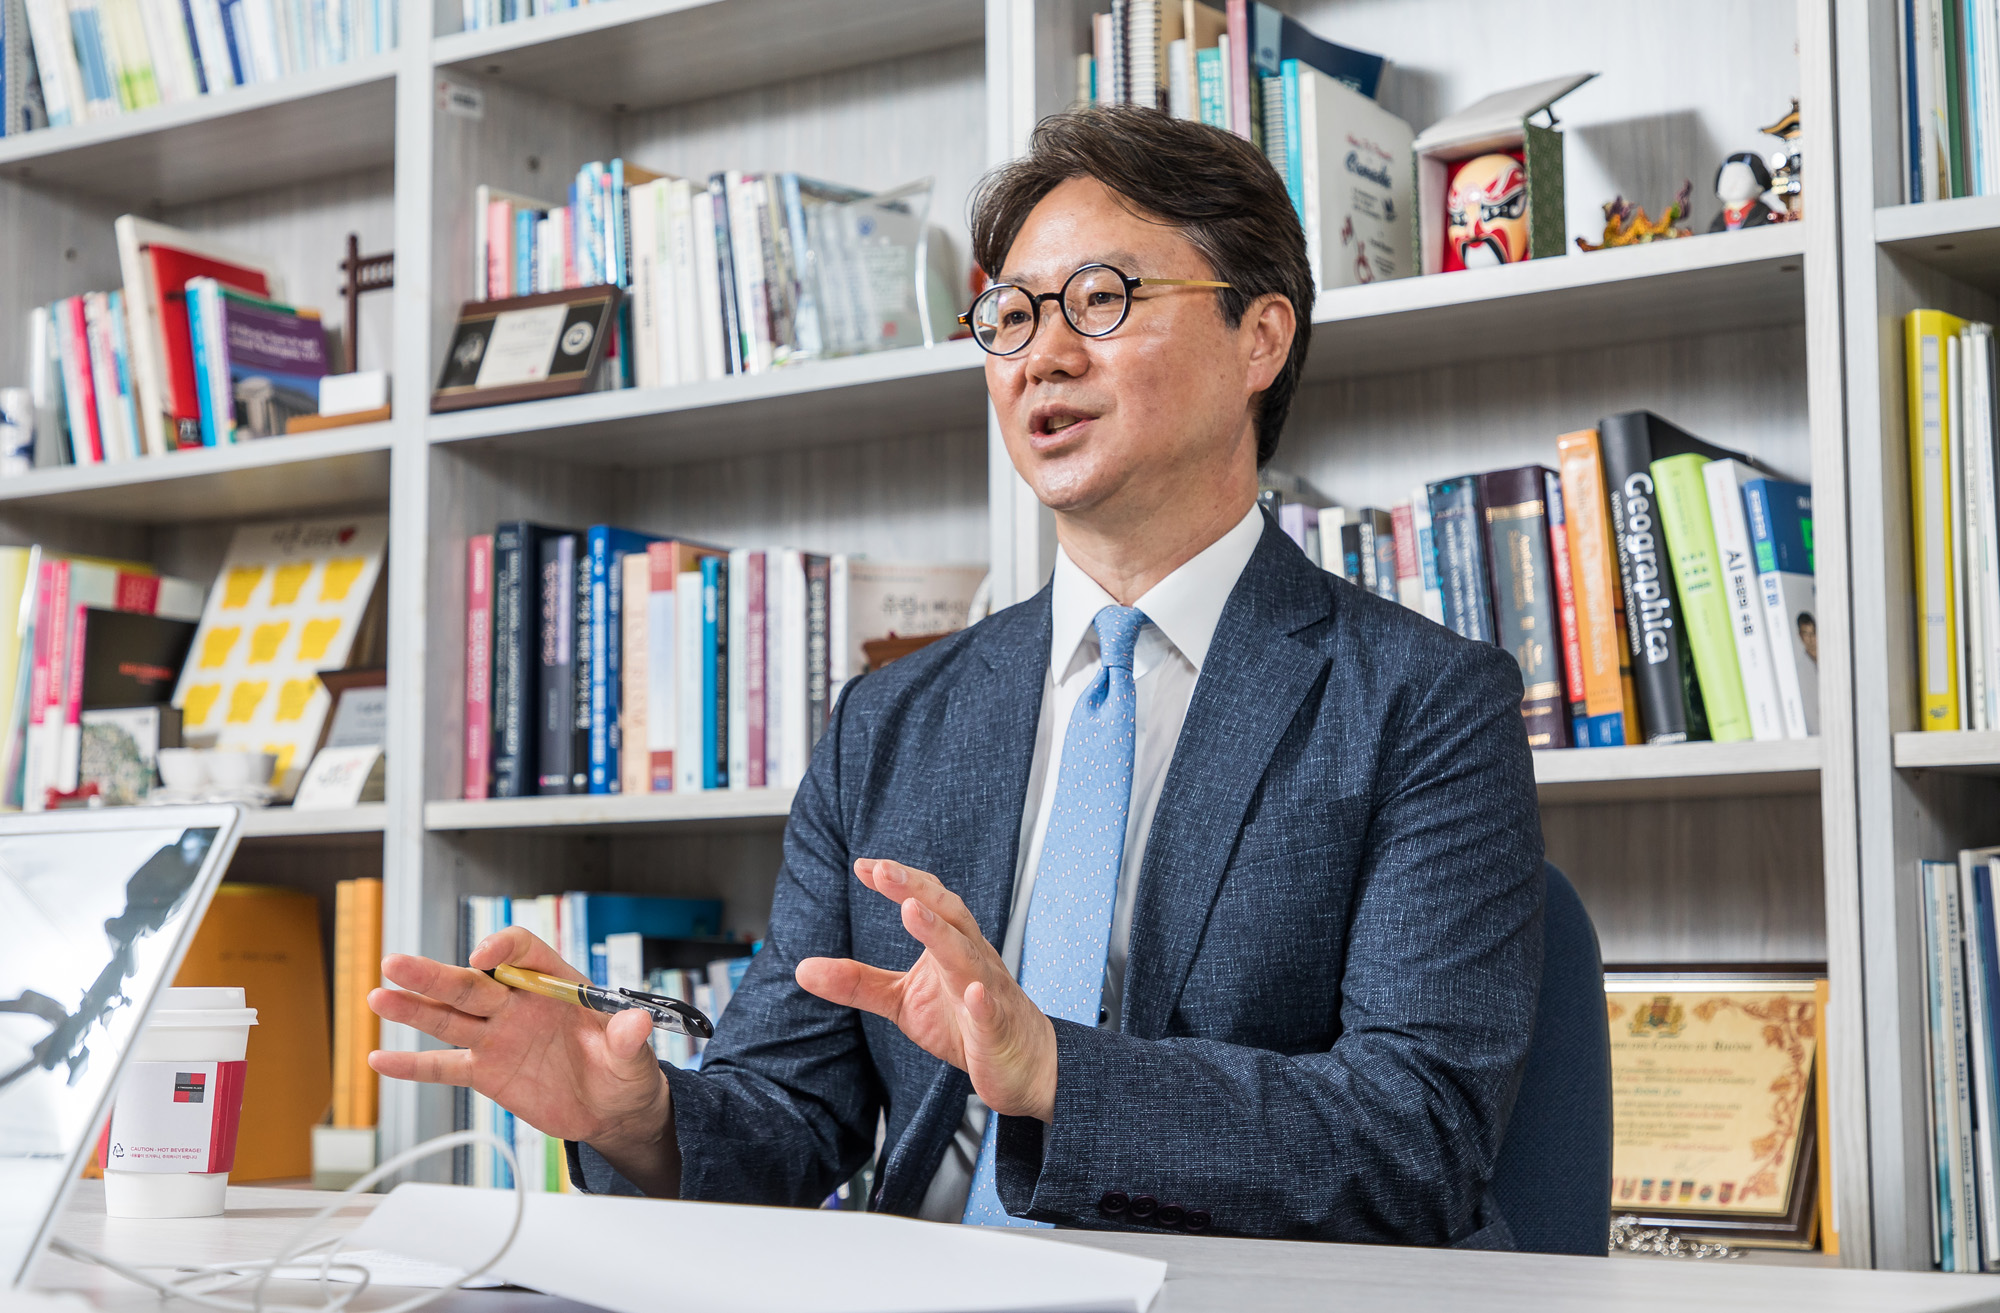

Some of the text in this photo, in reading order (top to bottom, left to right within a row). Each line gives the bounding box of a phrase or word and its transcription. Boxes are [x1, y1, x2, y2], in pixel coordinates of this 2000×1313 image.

[1610, 489, 1625, 534] WORLD
[1617, 534, 1630, 563] ATLAS
[1624, 472, 1673, 665] Geographica
[1726, 549, 1747, 572] AI
[1734, 574, 1749, 609] 최강의
[1624, 575, 1642, 656] ENCYCLOPEDIA
[1567, 642, 1584, 696] RESEARCH
